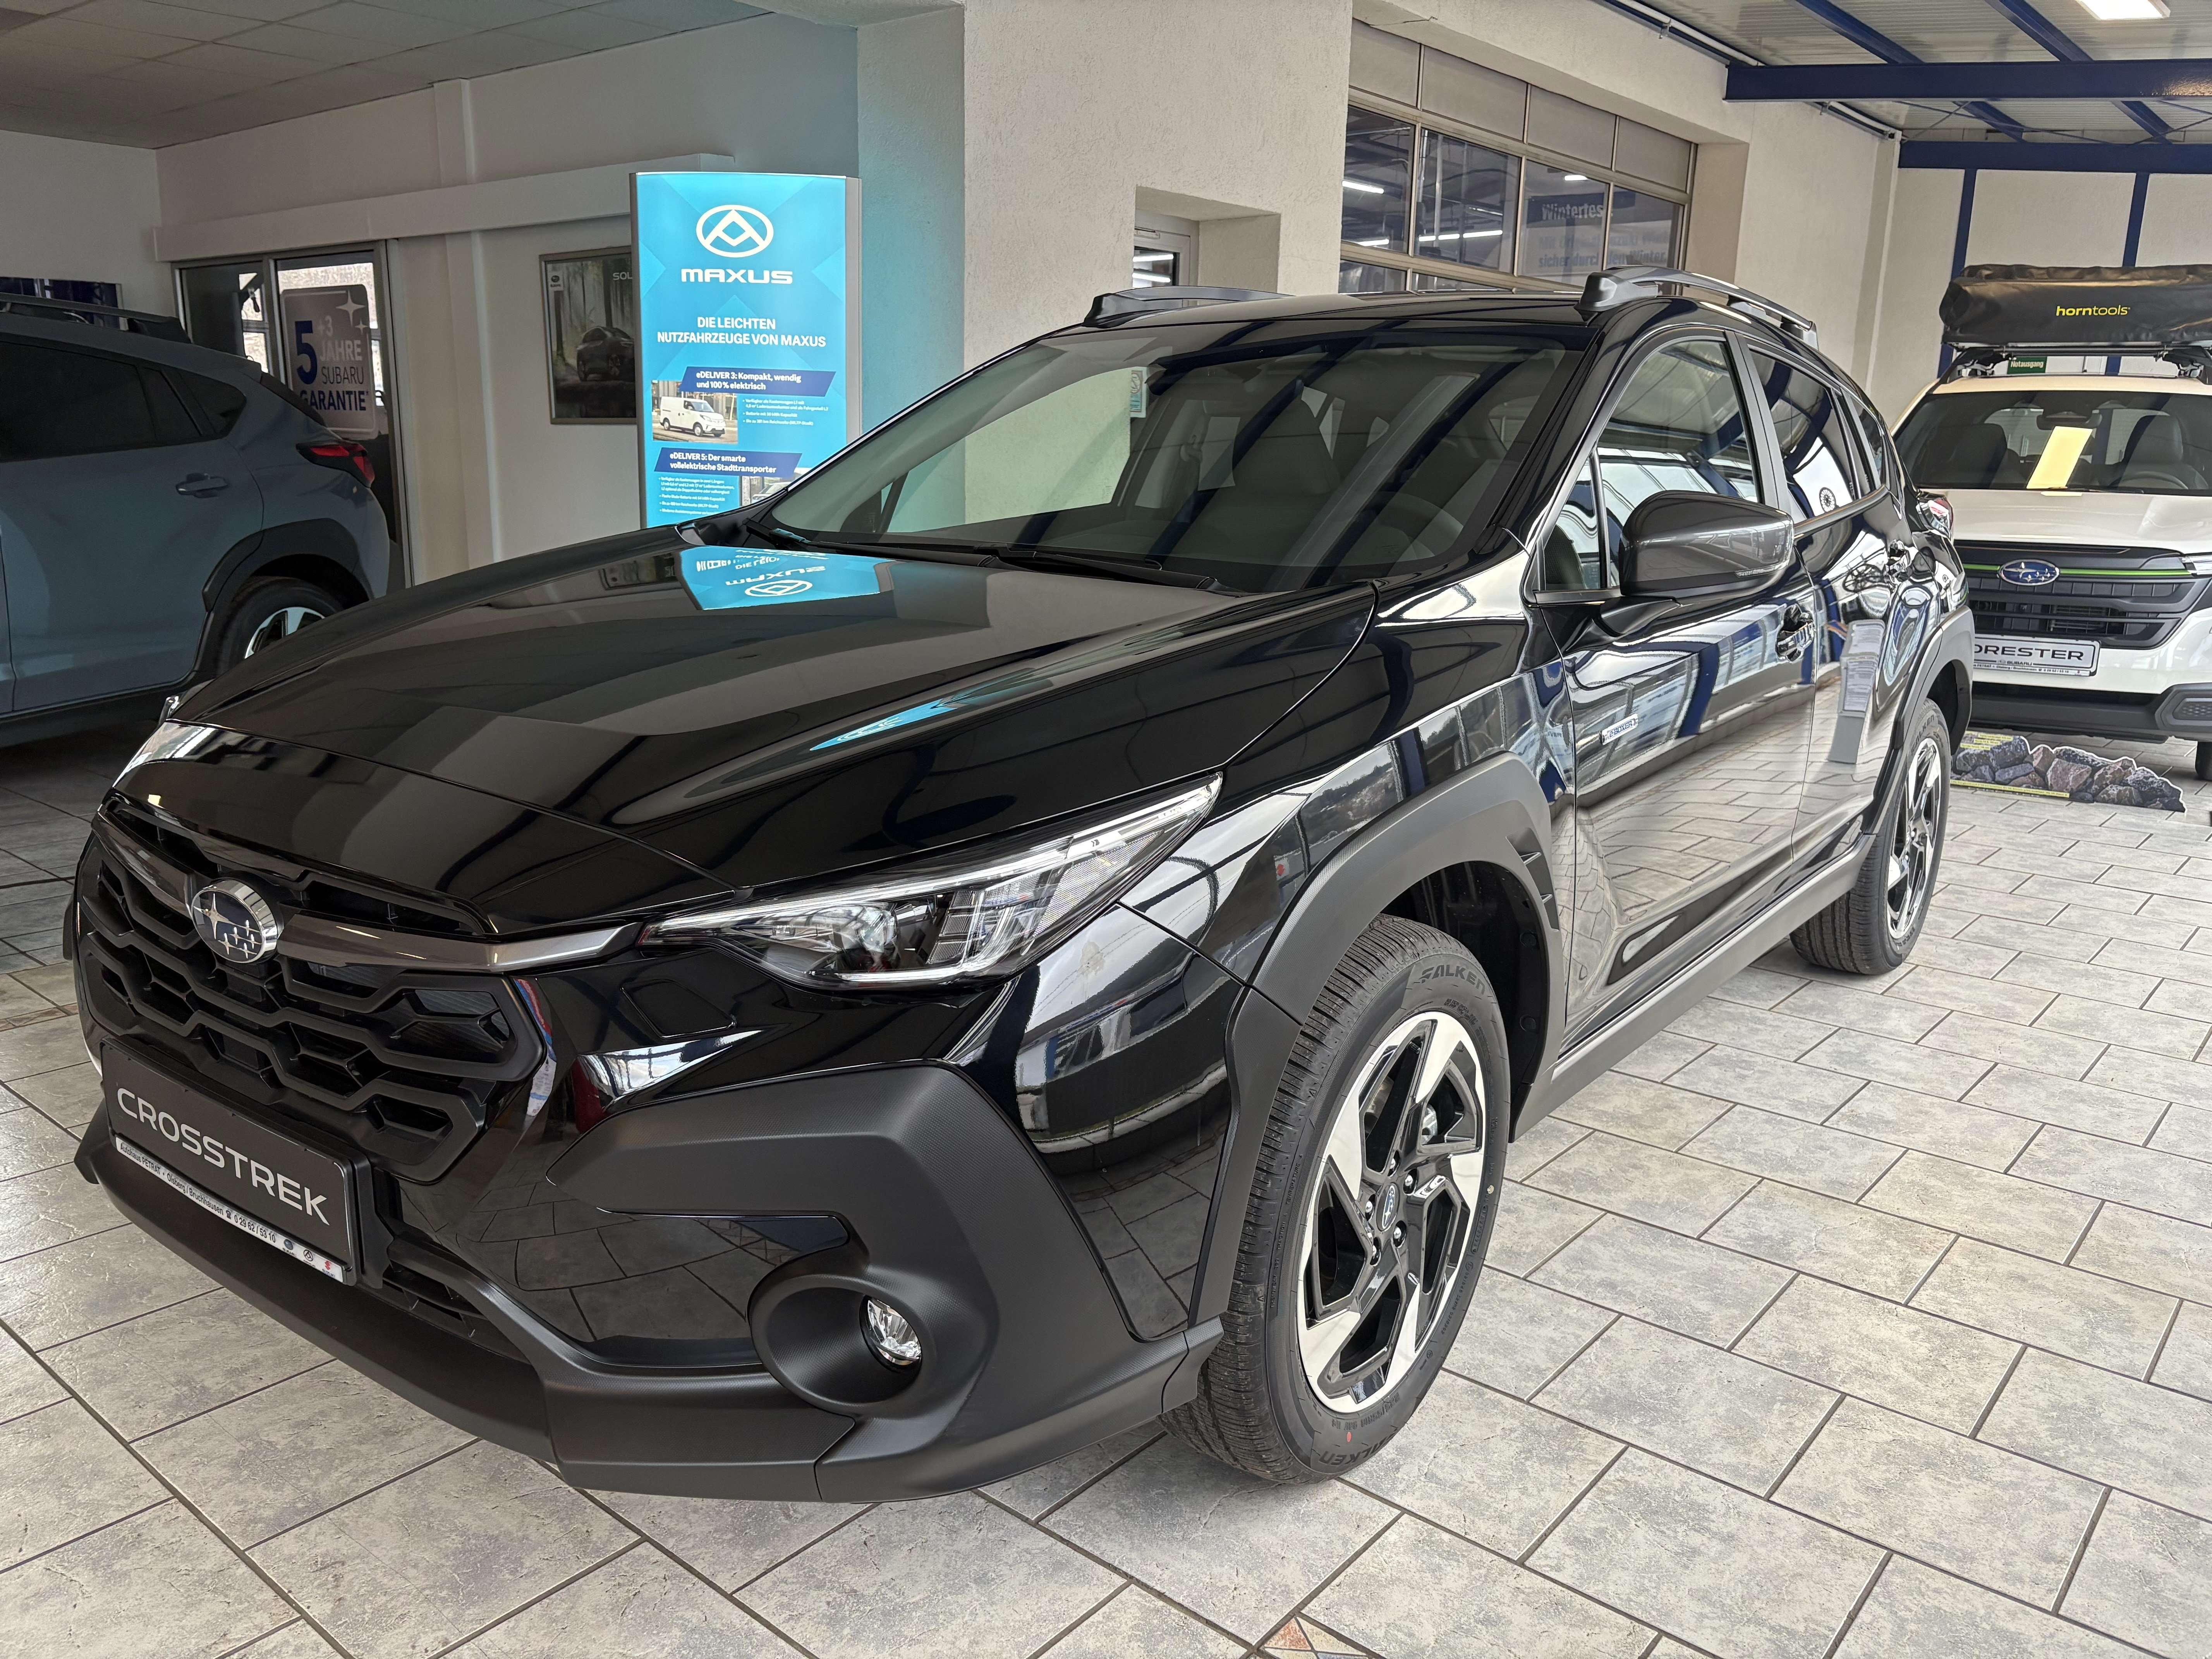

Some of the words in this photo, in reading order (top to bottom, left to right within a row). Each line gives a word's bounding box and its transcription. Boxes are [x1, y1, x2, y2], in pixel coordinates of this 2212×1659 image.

[1542, 203, 1613, 220] Winterfes
[681, 268, 793, 285] MAXUS
[2056, 304, 2128, 316] horntools
[697, 316, 716, 328] DIE
[718, 317, 776, 330] LEICHTEN
[657, 331, 750, 345] NUTZFAHRZEUGE
[751, 333, 779, 346] VON
[781, 335, 826, 348] MAXUS
[295, 320, 317, 385] 5
[319, 340, 362, 362] JAHRE
[322, 366, 364, 384] SUBARU
[696, 371, 730, 379] eDELIVER
[738, 373, 773, 381] Kompakt,
[774, 374, 801, 383] wendig
[730, 382, 766, 390] elektrisch
[670, 452, 700, 460] eDELIVER
[717, 463, 776, 474] Stadttransporter
[1419, 964, 1486, 995] FALKEN
[117, 1088, 330, 1226] CROSSTREK
[120, 1142, 141, 1163] Autohaus
[142, 1157, 160, 1175] PETRAT
[167, 1173, 185, 1193] Olsberg
[189, 1188, 223, 1216] Bruchhausen
[234, 1214, 238, 1223] 0
[239, 1217, 247, 1228] 29
[247, 1222, 255, 1233] 62
[259, 1228, 267, 1238] 53
[269, 1233, 276, 1243] 10
